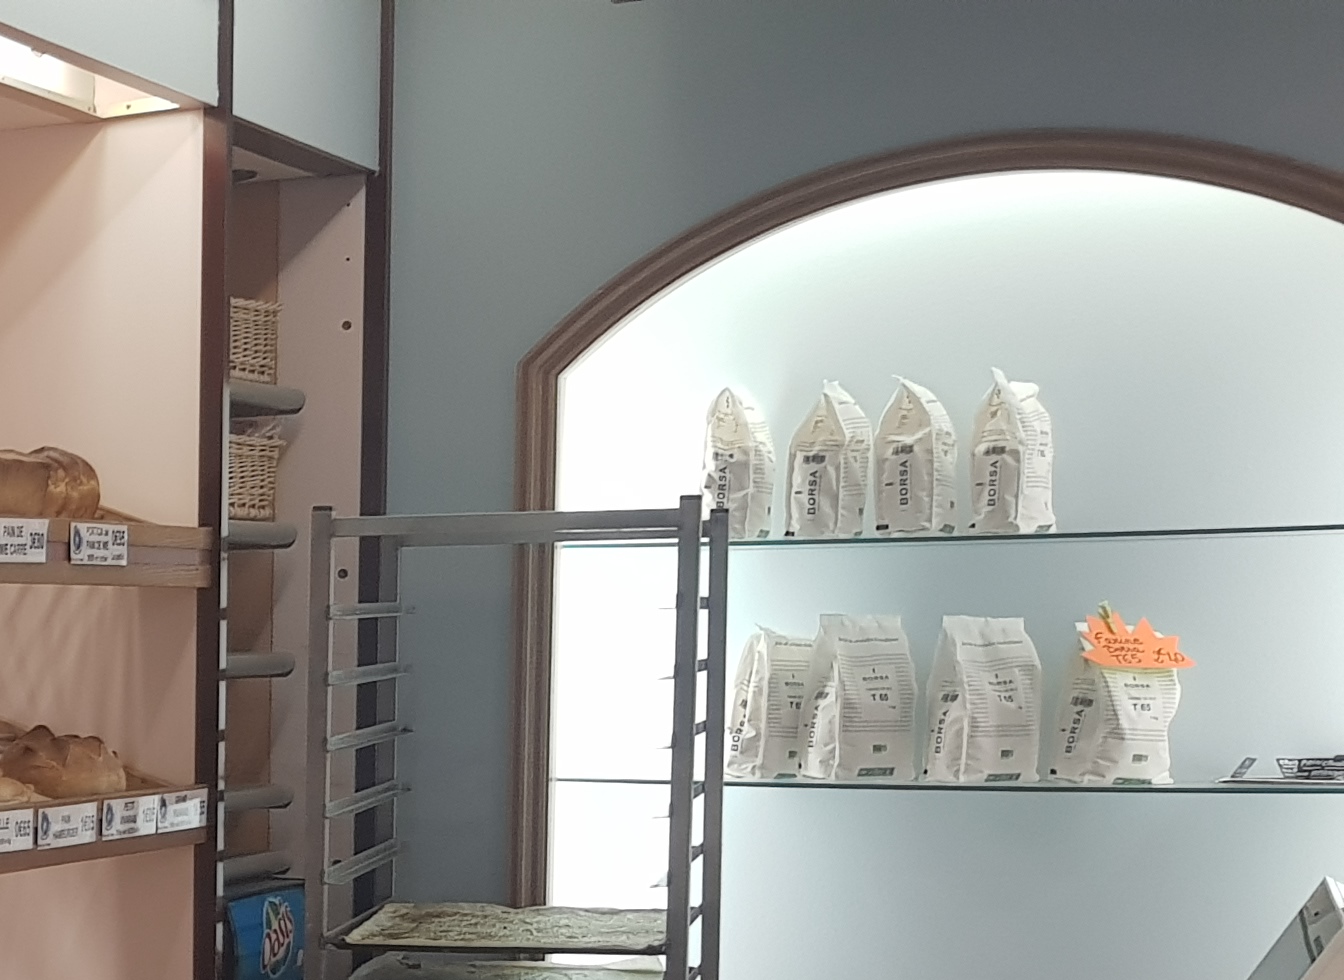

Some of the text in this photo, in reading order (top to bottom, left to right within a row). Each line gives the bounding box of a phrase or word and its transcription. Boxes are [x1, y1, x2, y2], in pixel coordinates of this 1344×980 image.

[807, 470, 818, 515] BORSA
[899, 460, 909, 505] BORSA
[987, 460, 999, 507] BORSA
[1112, 654, 1141, 664] T65
[935, 710, 949, 753] BORSA
[1065, 709, 1084, 754] BORSA
